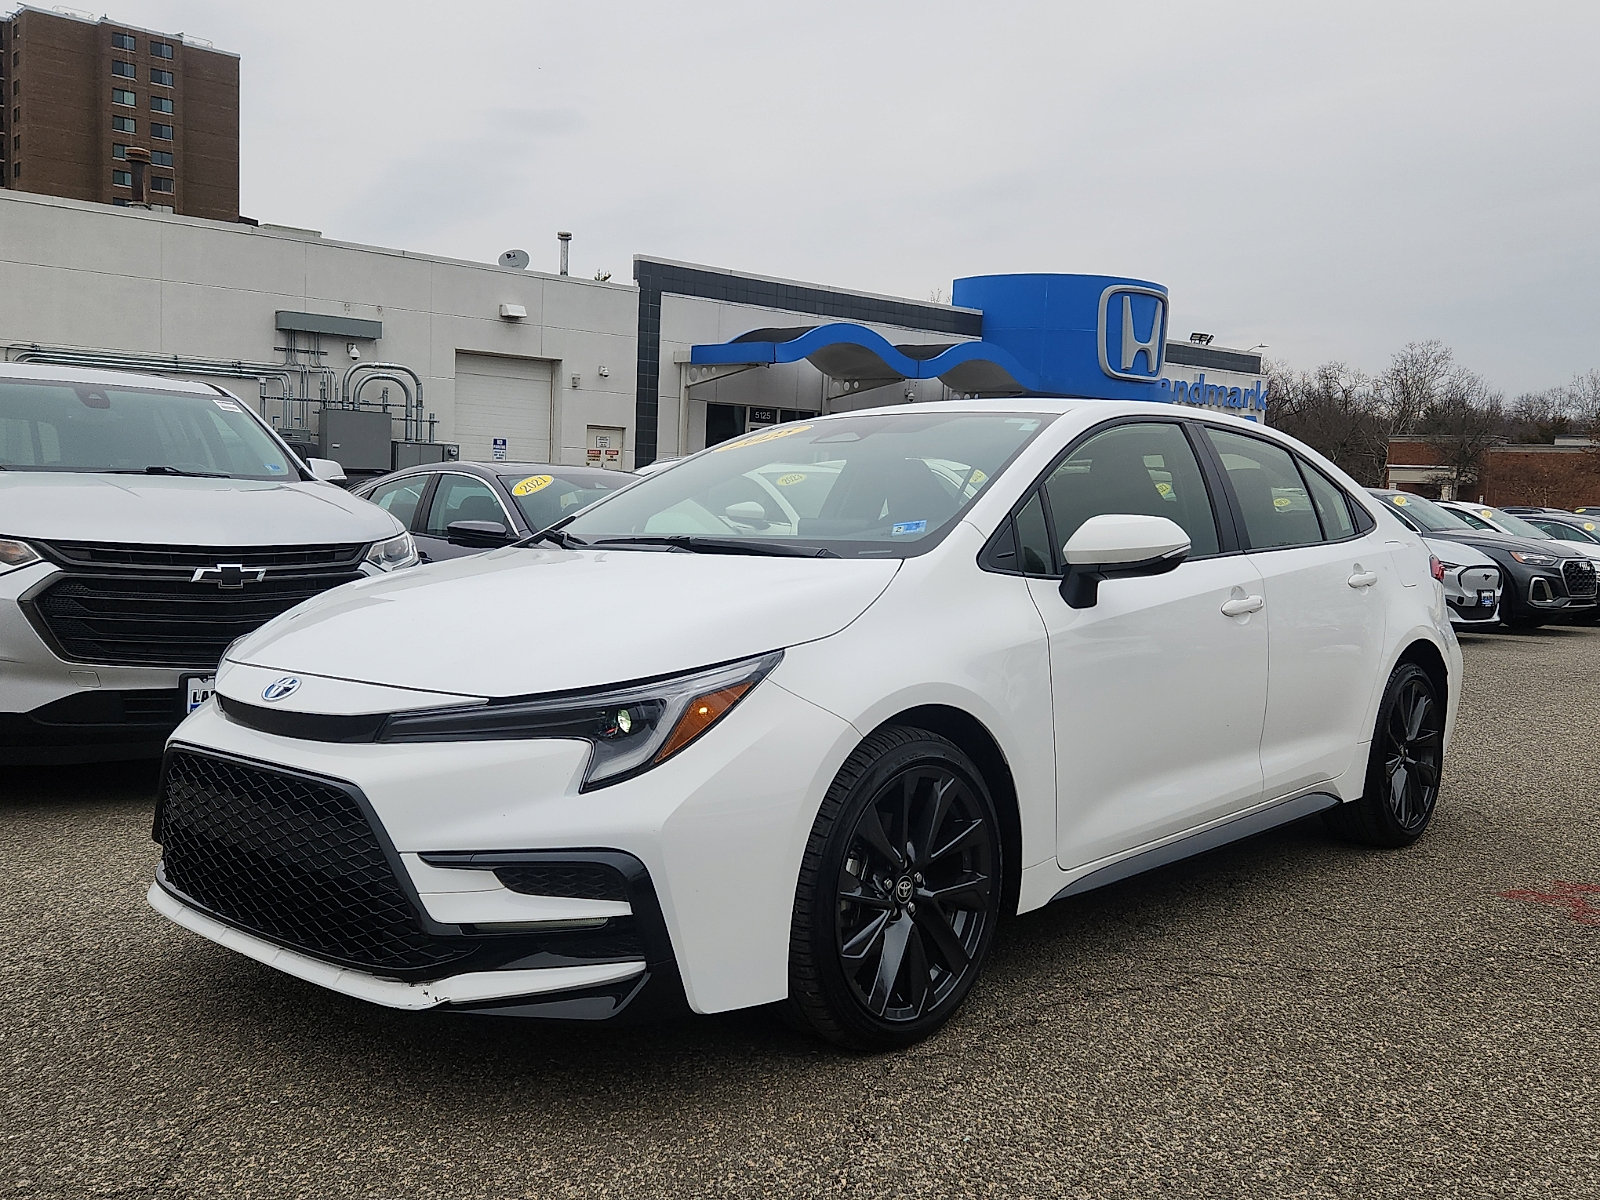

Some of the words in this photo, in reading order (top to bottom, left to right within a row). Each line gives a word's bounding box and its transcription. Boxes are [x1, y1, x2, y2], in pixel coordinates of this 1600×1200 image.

[1160, 374, 1268, 411] andmark
[755, 411, 771, 420] 5125
[520, 476, 548, 493] 2021
[192, 689, 216, 703] LA
